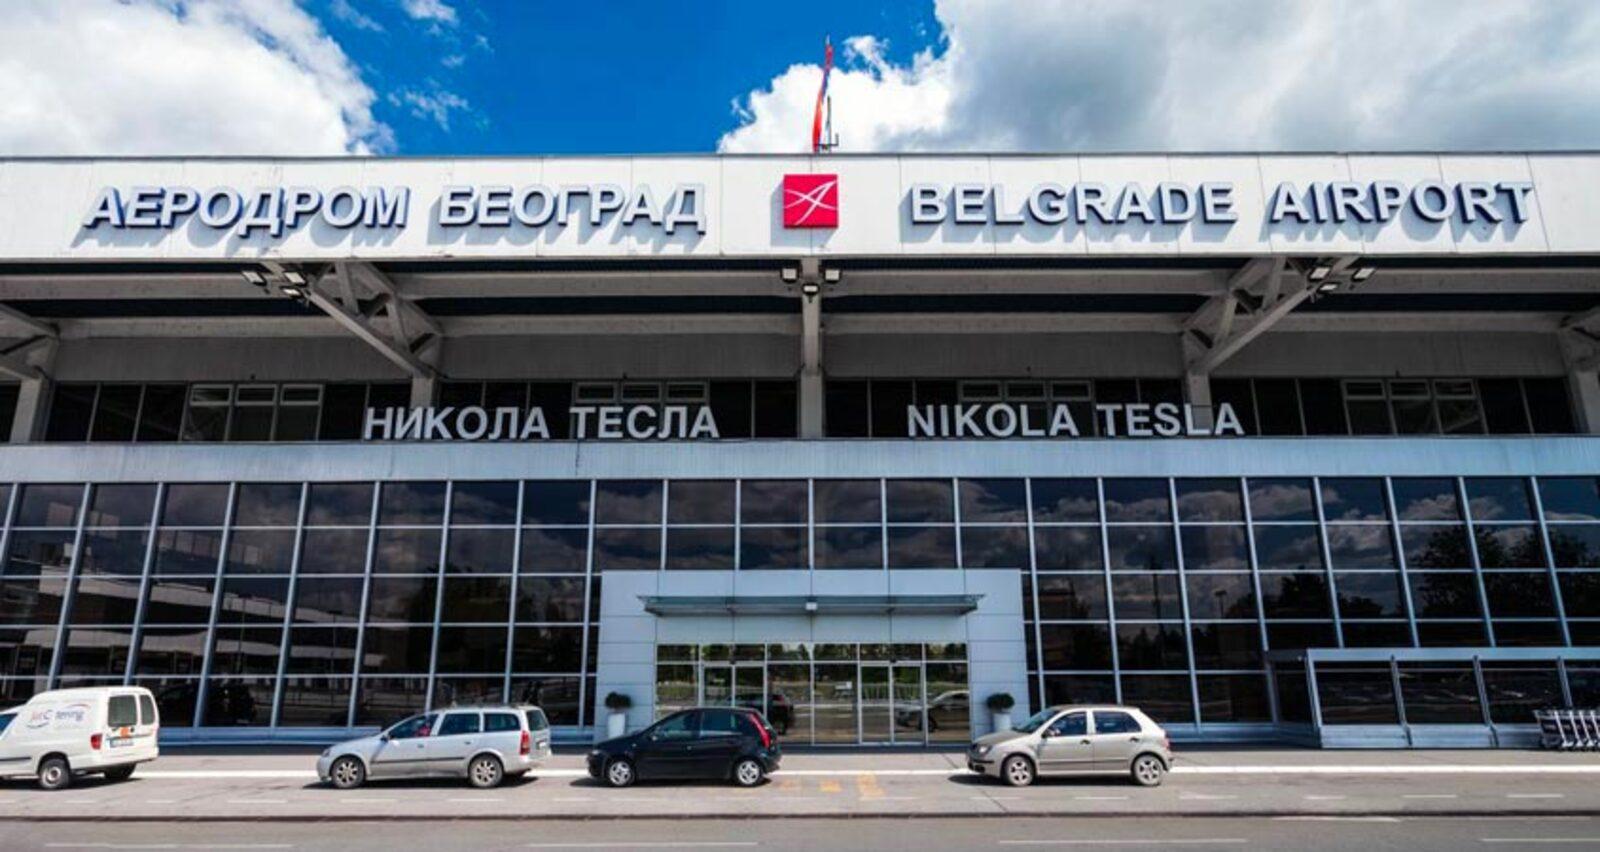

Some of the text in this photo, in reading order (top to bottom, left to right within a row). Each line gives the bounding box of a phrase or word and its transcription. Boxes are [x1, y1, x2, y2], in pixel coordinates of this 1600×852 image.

[83, 184, 706, 238] АЕРОДРОМ БЕОГРАД
[910, 180, 1533, 224] BELGRADE AIRPORT
[364, 405, 720, 440] НИКОЛА ТЕСЛА
[907, 402, 1245, 437] NIKOLA TESLA
